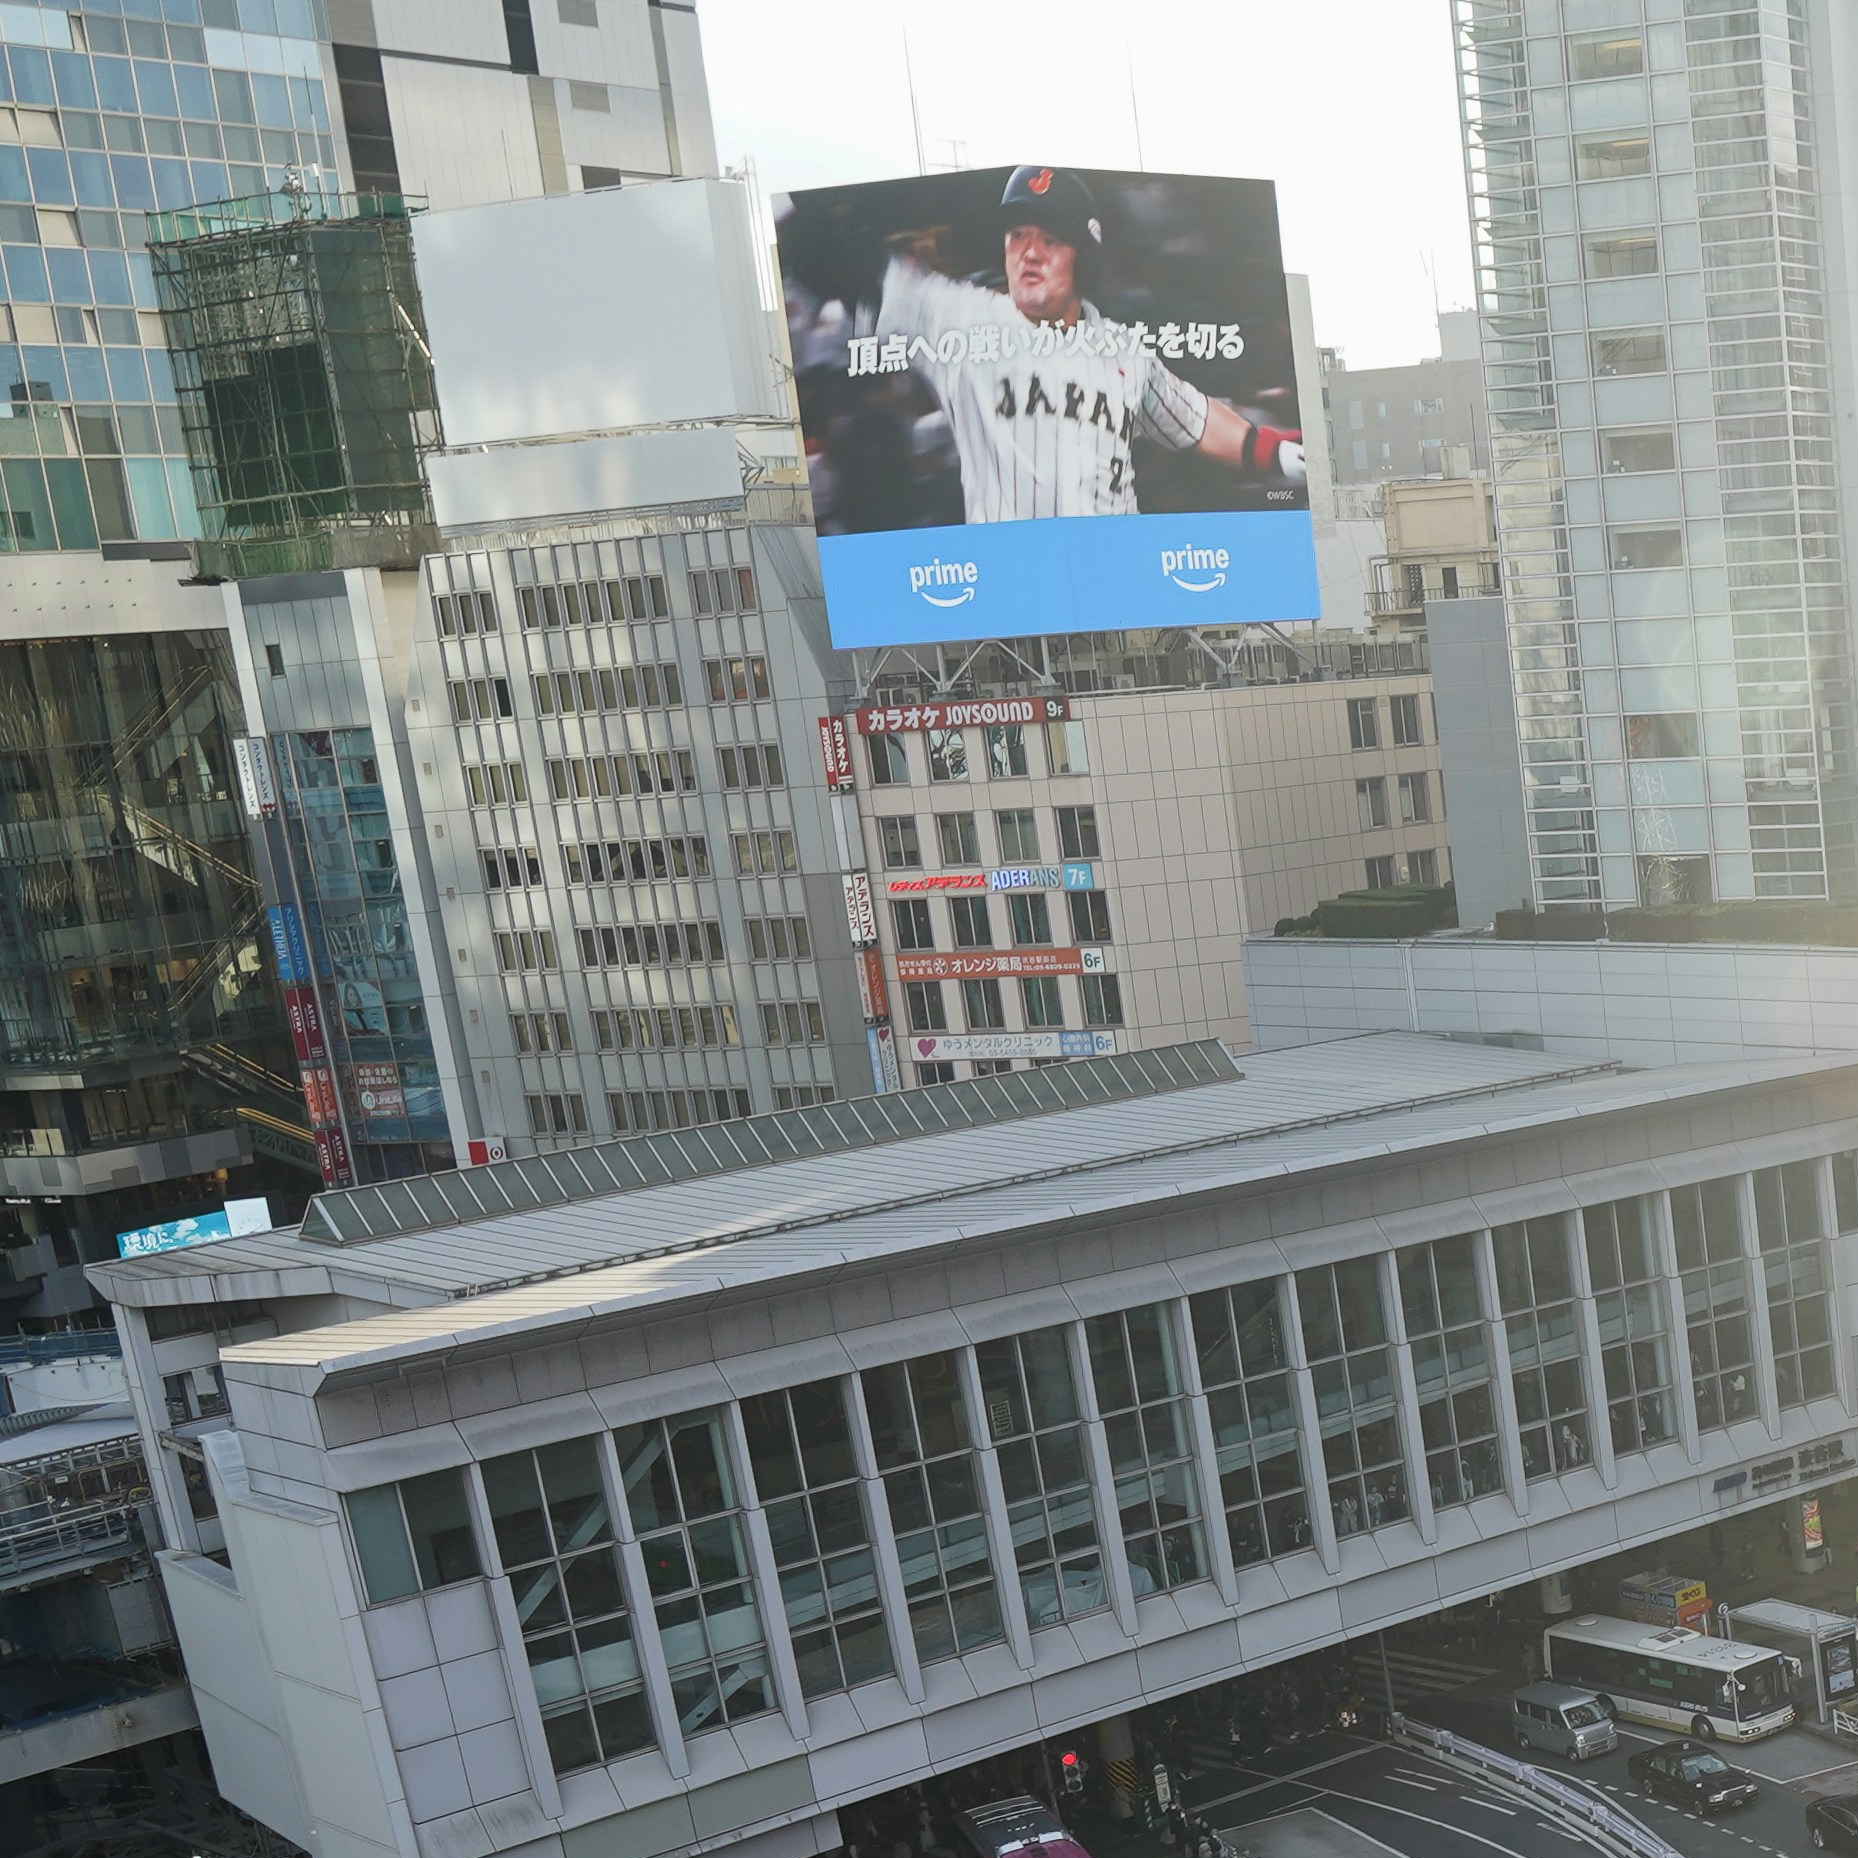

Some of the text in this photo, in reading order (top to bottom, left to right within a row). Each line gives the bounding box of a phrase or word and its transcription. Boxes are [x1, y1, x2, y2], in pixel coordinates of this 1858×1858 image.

[848, 319, 1244, 377] 頂点への戦いが火ぶたを切る
[910, 558, 979, 592] prime
[1161, 544, 1230, 576] prime
[868, 700, 1065, 732] カラオケ JOYSOUND 9F
[832, 719, 851, 773] カラオケ
[991, 867, 1087, 892] ADERANS 7F
[844, 886, 860, 930] アデランス
[853, 876, 874, 937] アデランス
[952, 956, 1023, 974] オレンジ薬局
[1084, 953, 1102, 969] 6F
[1096, 1036, 1113, 1051] 6F
